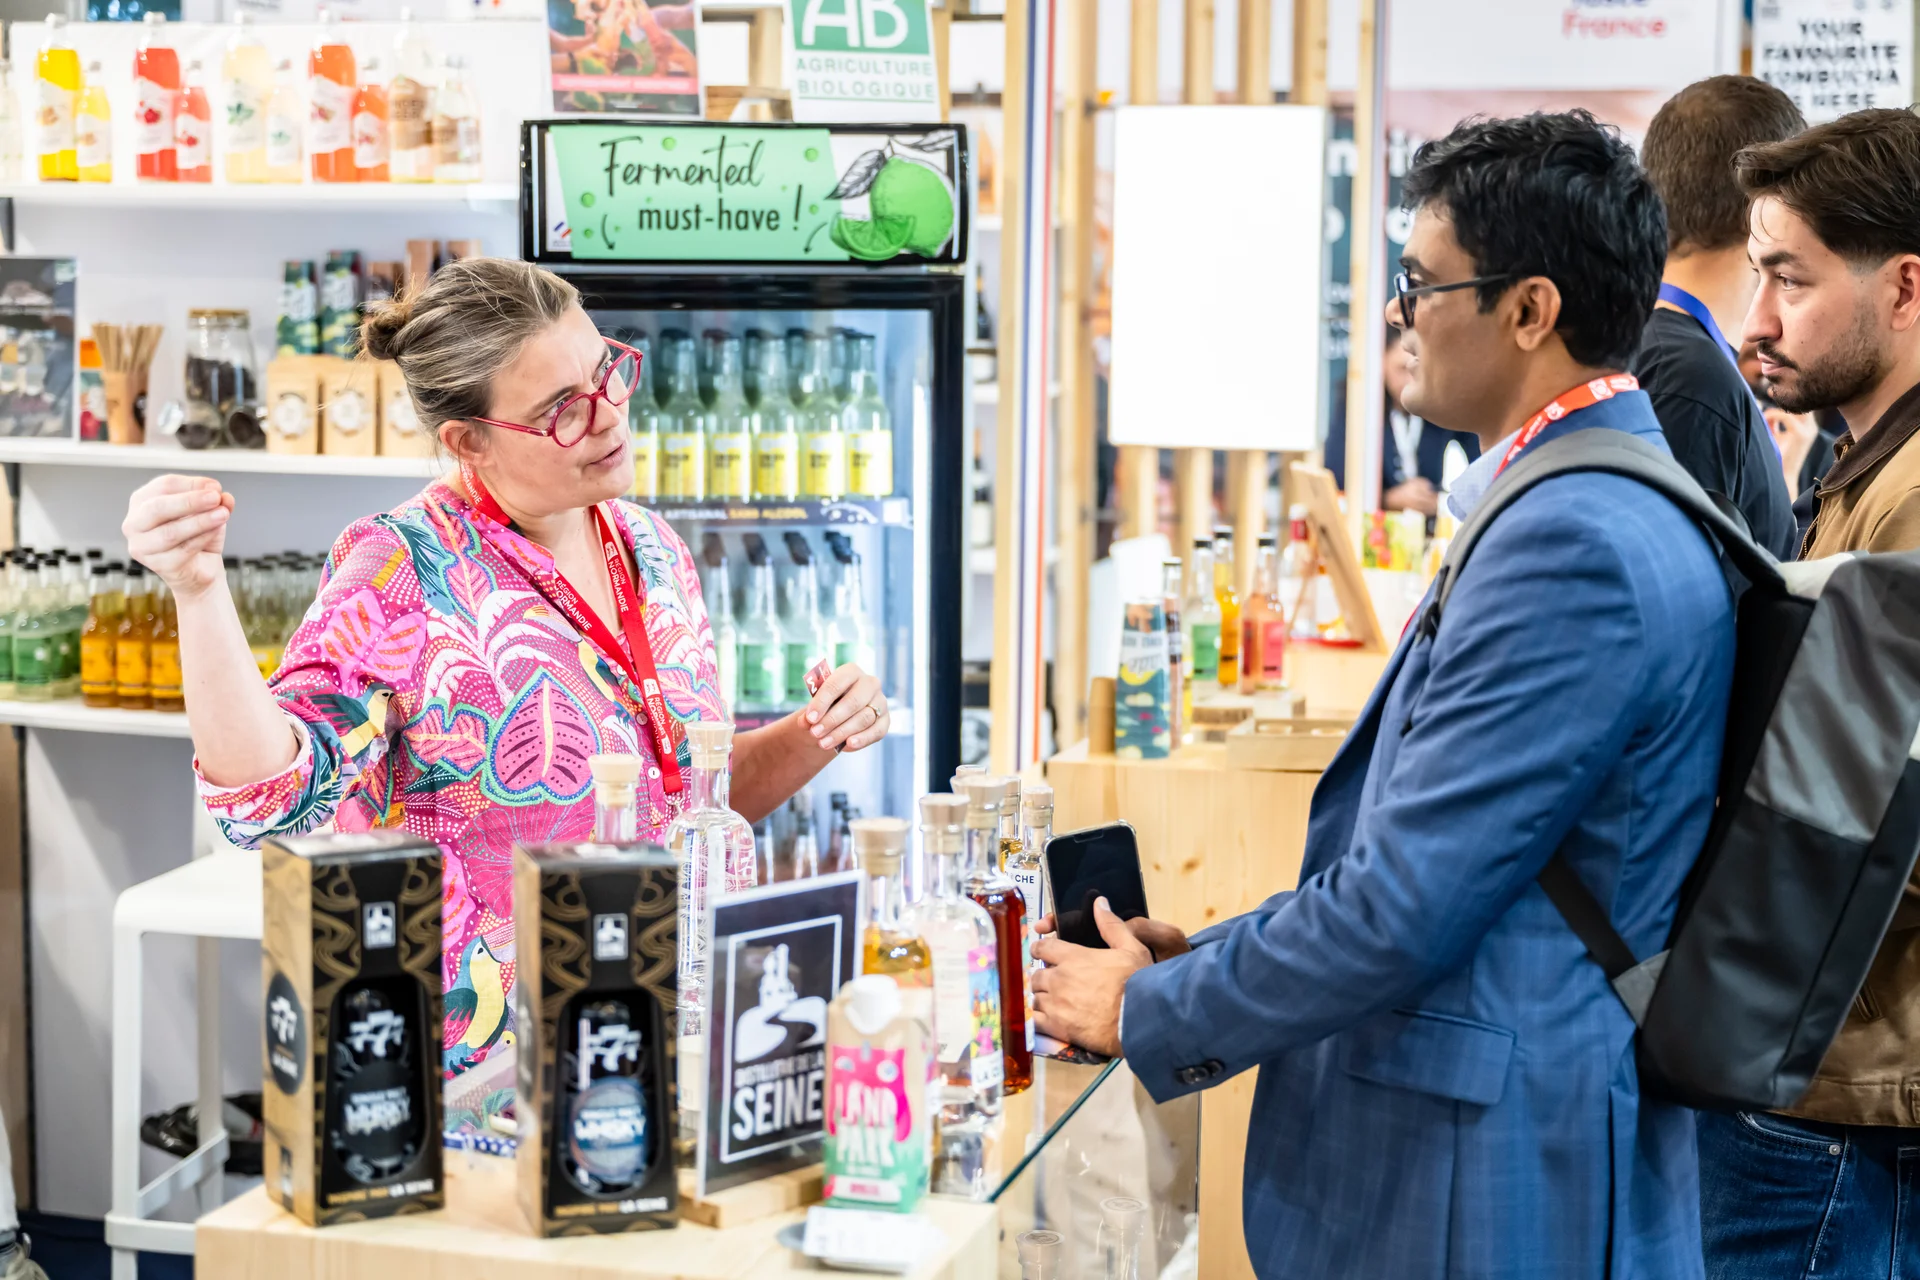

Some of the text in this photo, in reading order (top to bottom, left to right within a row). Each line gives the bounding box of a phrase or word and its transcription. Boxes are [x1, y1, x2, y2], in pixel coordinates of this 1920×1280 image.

[801, 0, 909, 48] AB
[1562, 10, 1668, 39] France
[1799, 20, 1863, 37] YOUR
[1763, 44, 1899, 61] FAVOURITE
[796, 58, 933, 76] AGRICULTURE
[797, 79, 936, 98] BIOLOGIQUE
[1812, 93, 1877, 107] HERE
[600, 134, 765, 197] Fermented
[638, 184, 803, 231] must-have !
[555, 579, 579, 604] RÉGION
[608, 561, 629, 613] NORMANDIE
[654, 697, 667, 725] RÉGION
[732, 1071, 824, 1140] SEINE
